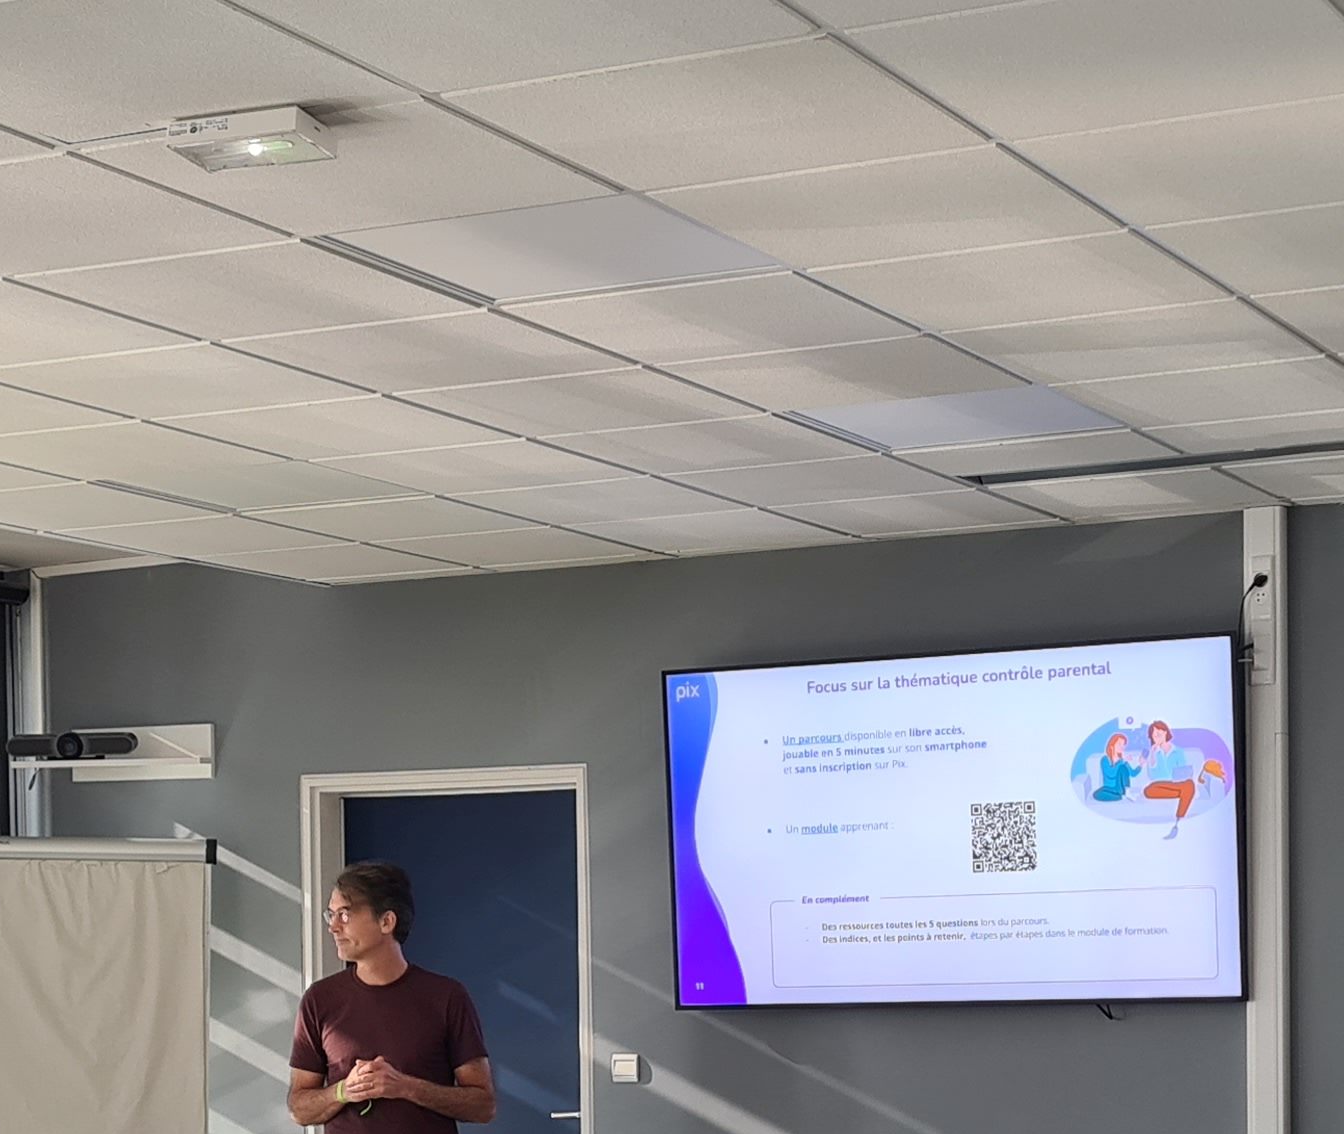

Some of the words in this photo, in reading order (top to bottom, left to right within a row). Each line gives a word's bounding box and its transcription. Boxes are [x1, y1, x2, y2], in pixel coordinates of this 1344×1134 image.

[807, 680, 847, 694] Focus
[851, 681, 873, 692] sur
[877, 676, 891, 690] la
[895, 671, 978, 688] thématique
[982, 665, 1043, 682] contrôle
[1047, 661, 1112, 681] parental
[676, 681, 700, 702] pix
[782, 735, 796, 746] Un
[798, 734, 842, 746] parcours
[844, 729, 892, 743] disponible
[894, 730, 906, 739] en
[909, 727, 932, 737] libre
[935, 725, 965, 736] accès,
[782, 749, 819, 761] jouable
[821, 749, 833, 757] en
[836, 747, 842, 757] 5
[844, 746, 885, 756] minutes
[887, 745, 902, 754] sur
[904, 744, 922, 752] son
[925, 740, 987, 752] smartphone
[783, 766, 792, 774] et
[795, 765, 816, 774] sans
[819, 761, 872, 774] inscription
[874, 761, 890, 770] sur
[786, 824, 799, 834] Un
[801, 823, 839, 835] module
[840, 822, 889, 833] apprenant
[801, 896, 813, 905] En
[815, 894, 870, 905] complément
[821, 922, 837, 931] Des
[839, 922, 884, 931] ressources
[885, 920, 913, 930] toutes
[915, 920, 927, 929] les
[929, 919, 934, 928] 5
[936, 918, 978, 930] questions
[822, 935, 837, 944] Des
[839, 934, 872, 944] indices,
[883, 933, 896, 942] les
[897, 932, 924, 944] points
[926, 931, 932, 940] à
[934, 931, 967, 941] retenir,
[1077, 927, 1110, 937] module
